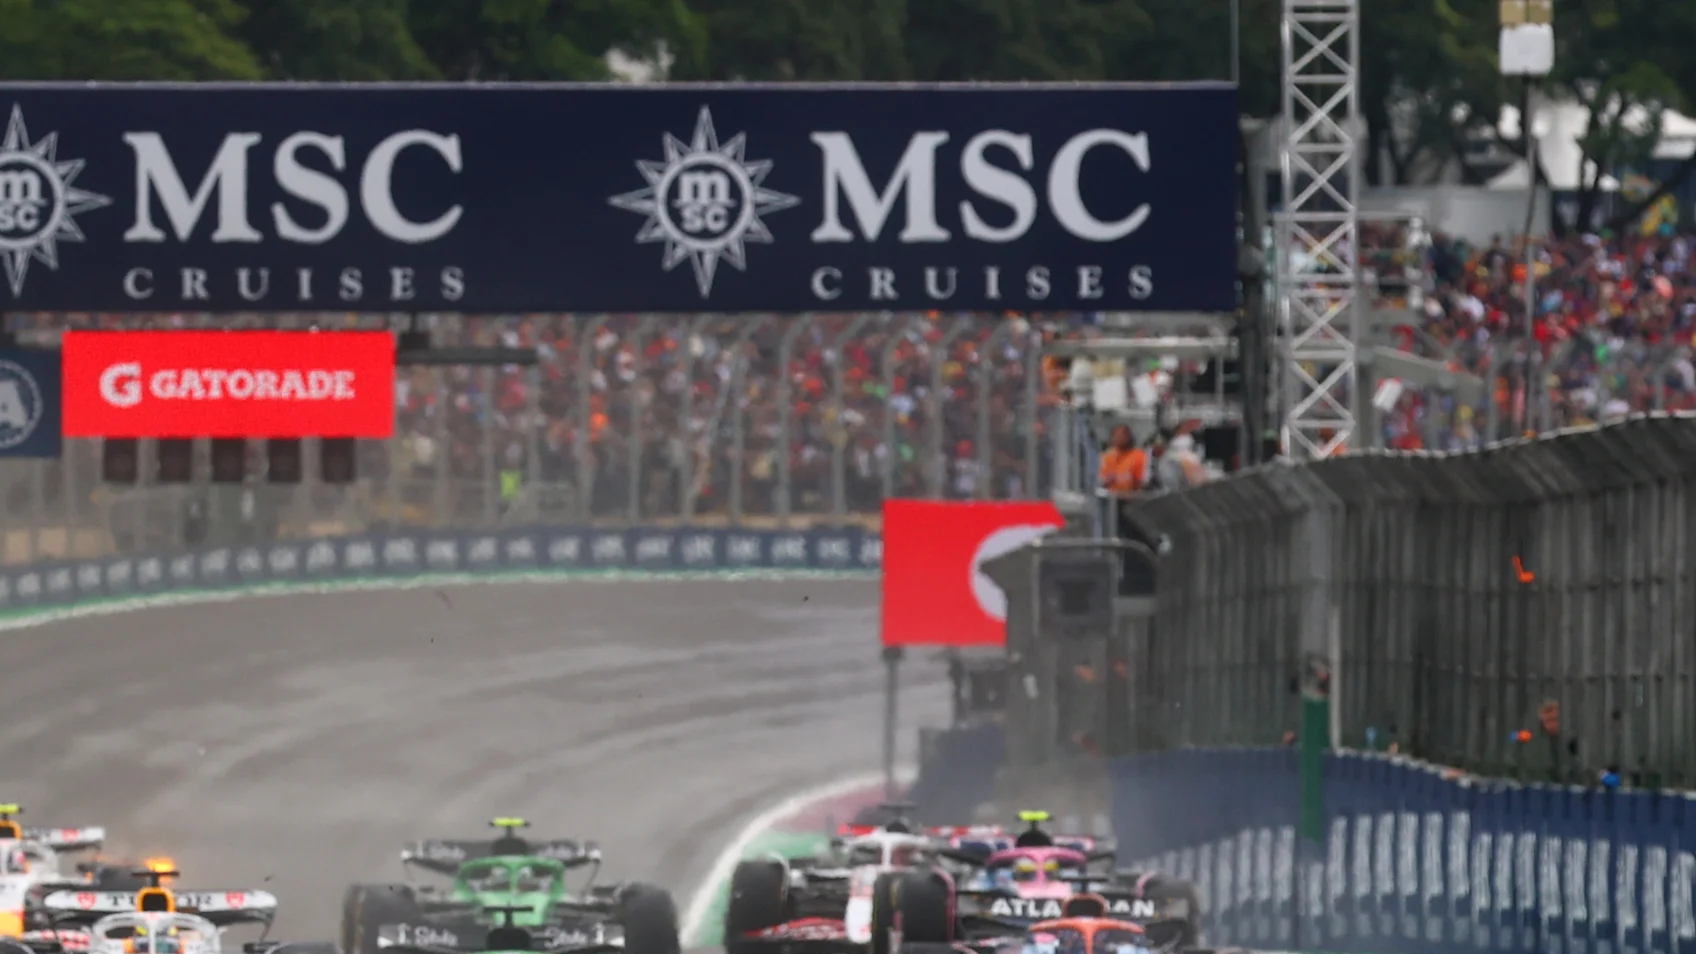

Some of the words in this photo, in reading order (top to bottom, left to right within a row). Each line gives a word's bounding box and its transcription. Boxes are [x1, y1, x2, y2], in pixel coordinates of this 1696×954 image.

[123, 129, 464, 244] MSC
[810, 129, 1151, 243] MSC
[123, 267, 465, 300] CRUISES
[811, 266, 1153, 300] CRUISES
[150, 369, 356, 400] GATORADE
[991, 898, 1155, 918] ATLAAN
